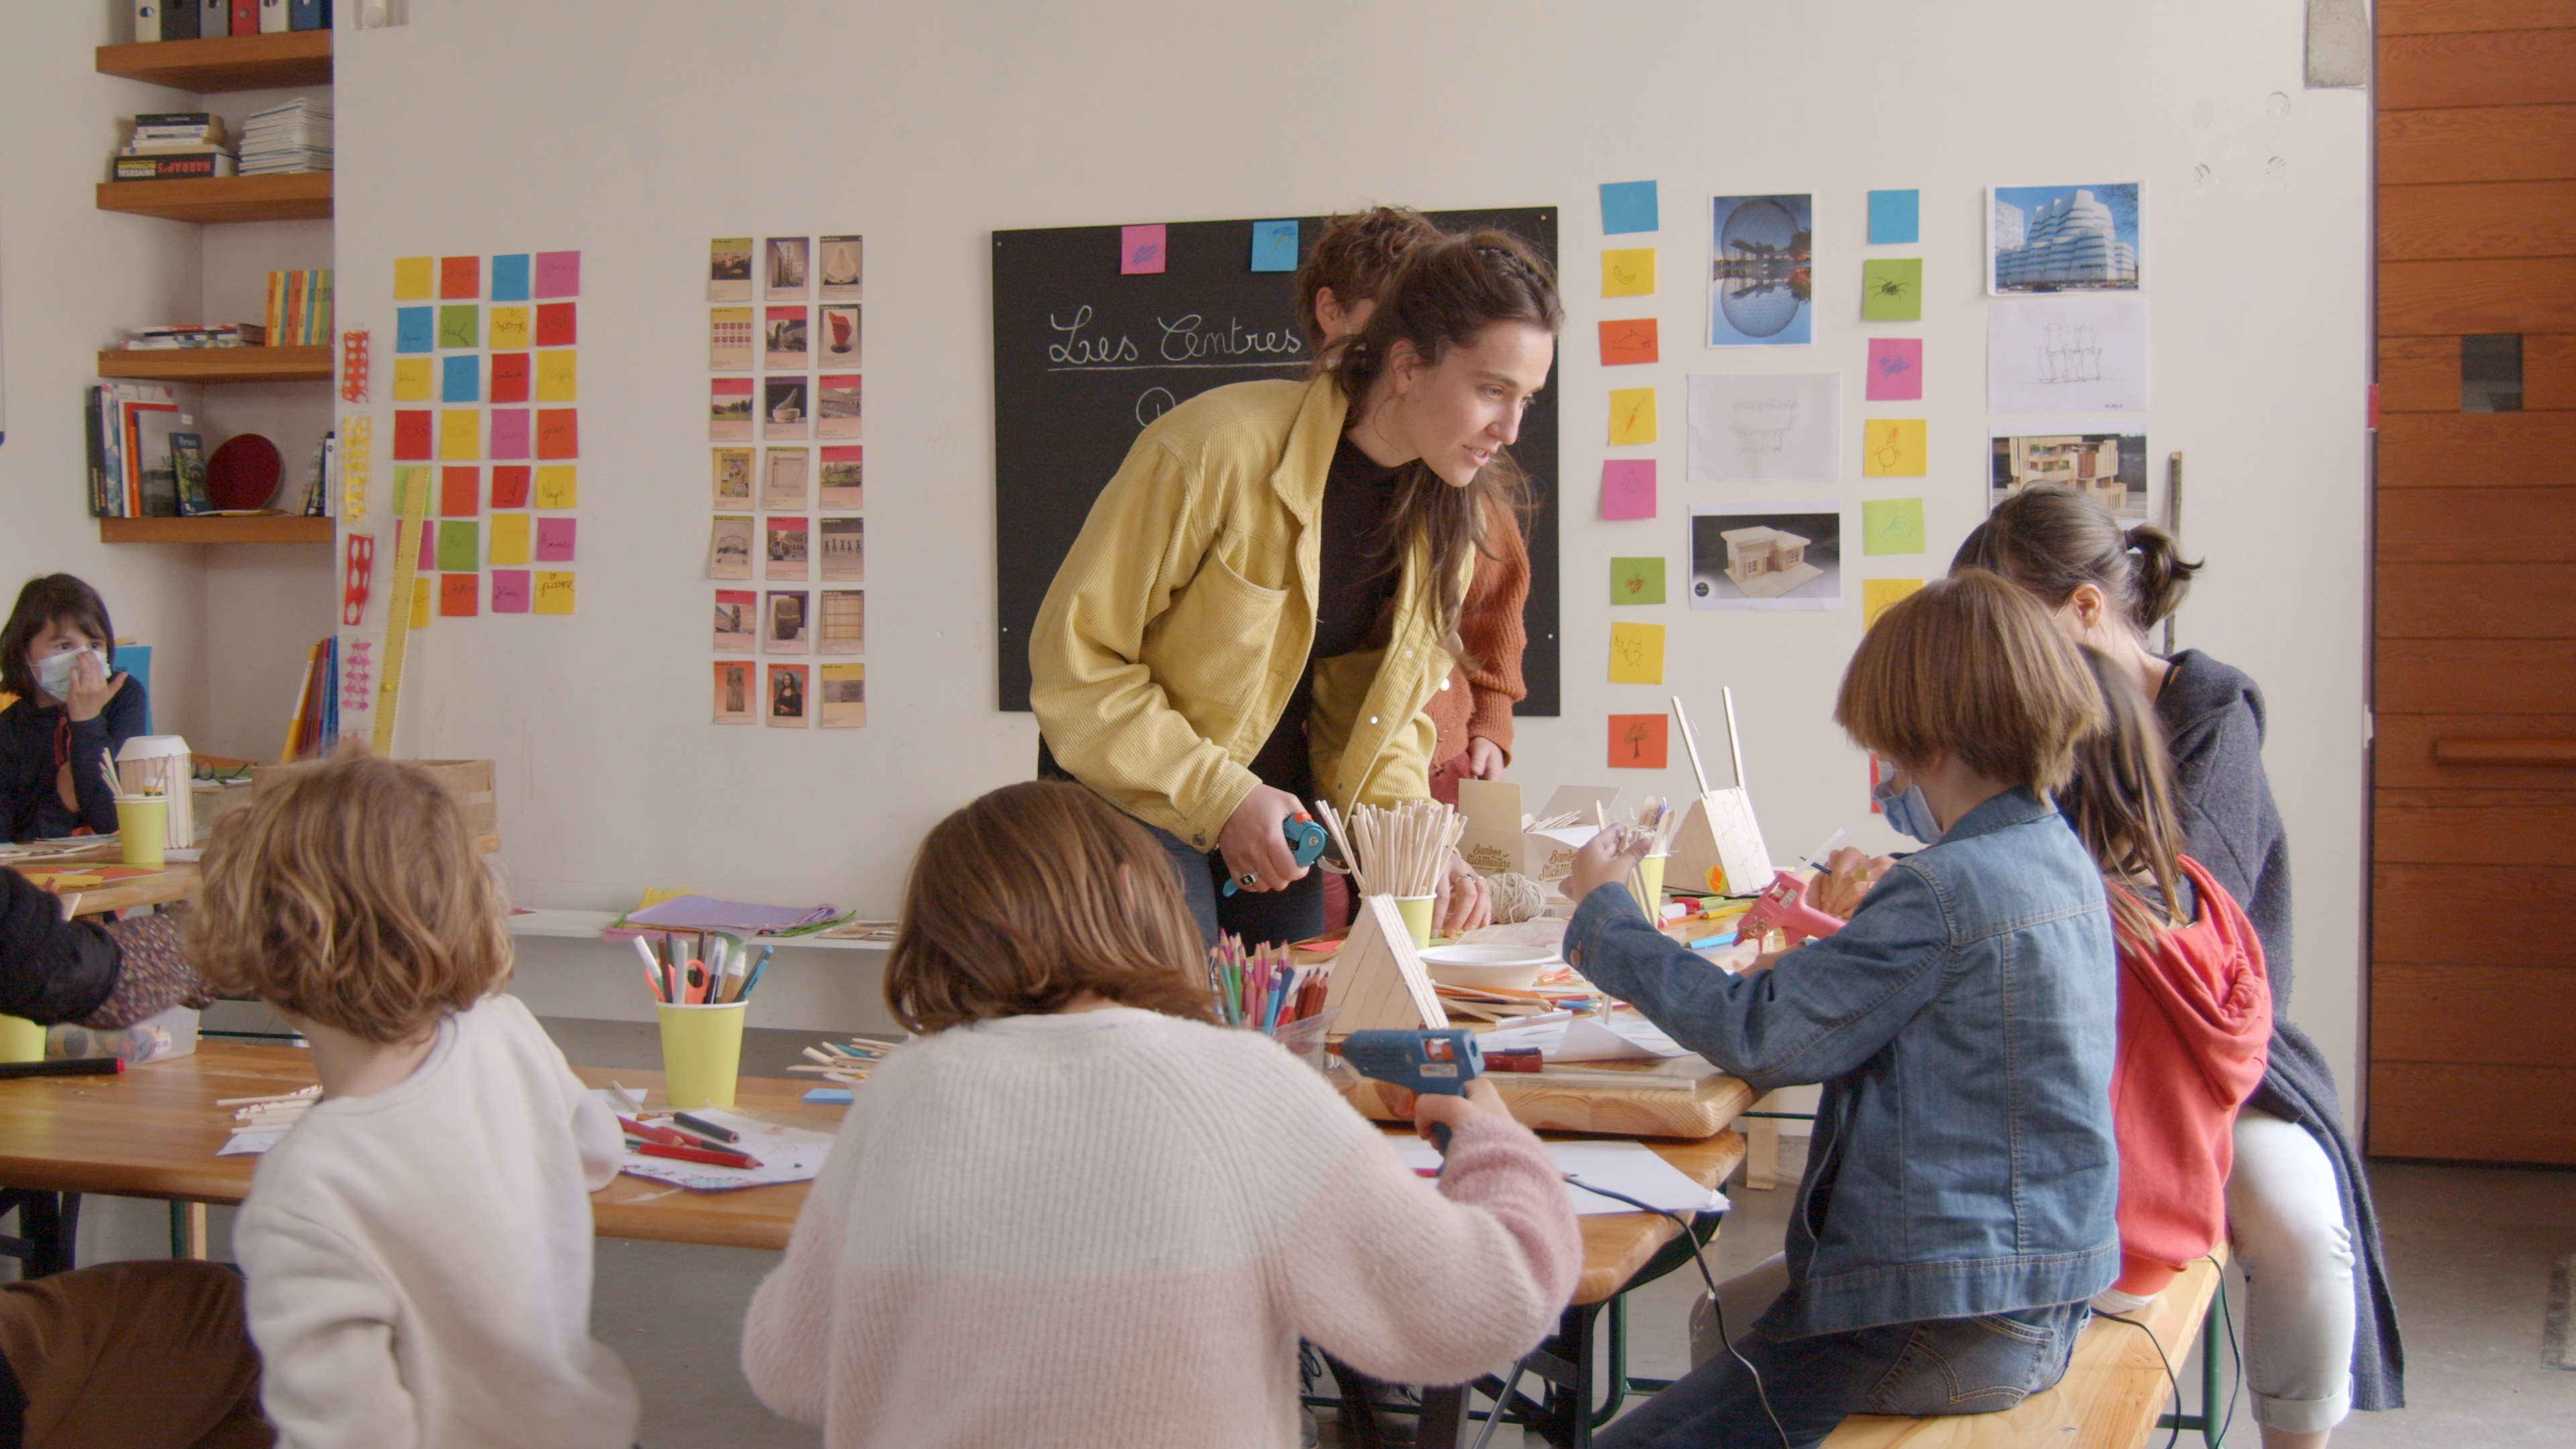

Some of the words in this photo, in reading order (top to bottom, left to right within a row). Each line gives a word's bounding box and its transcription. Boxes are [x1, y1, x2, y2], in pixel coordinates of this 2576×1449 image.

[156, 160, 211, 174] HARRAP'S
[1049, 305, 1138, 364] Les
[1157, 314, 1302, 362] Centres
[1472, 843, 1502, 856] Bamboo
